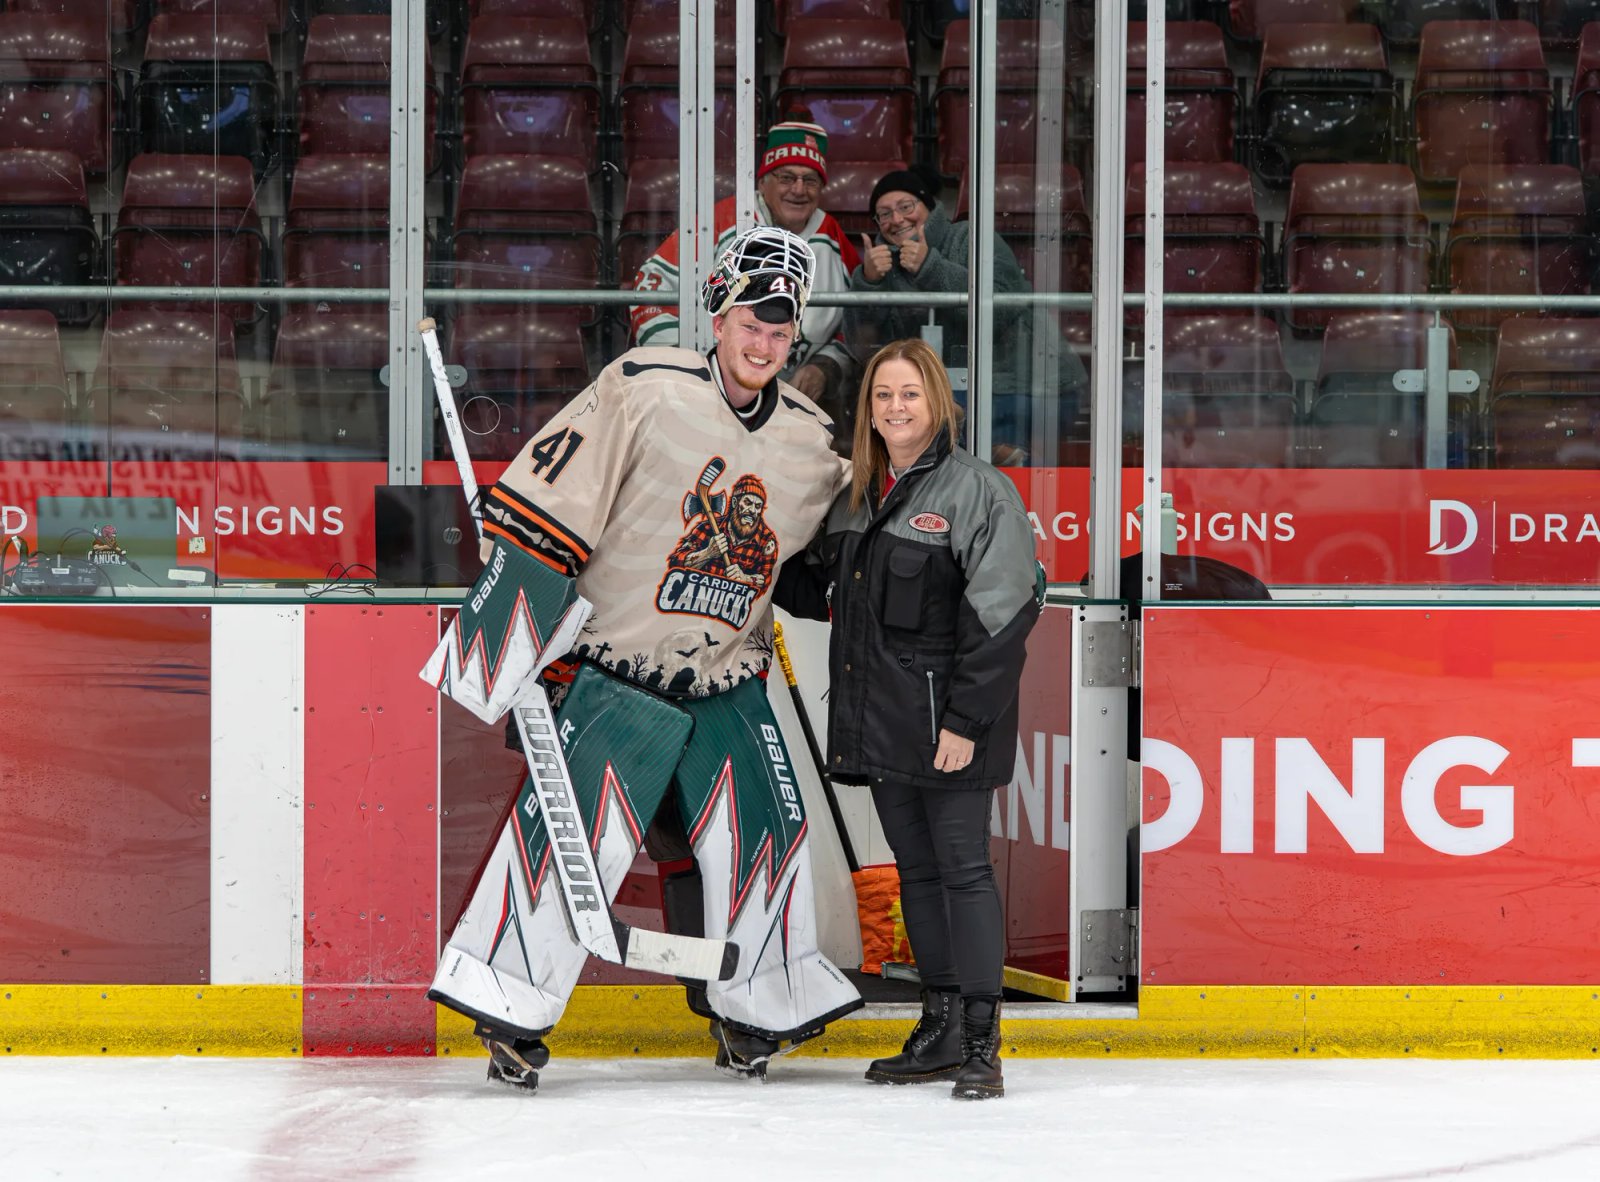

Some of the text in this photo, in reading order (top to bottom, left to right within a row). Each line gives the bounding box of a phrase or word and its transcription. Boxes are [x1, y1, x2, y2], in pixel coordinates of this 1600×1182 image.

[769, 276, 796, 297] 41
[530, 425, 585, 486] 41
[214, 506, 344, 536] SIGNS
[1509, 513, 1600, 543] DRA
[470, 546, 507, 614] BAUER
[659, 571, 757, 629] CANUCKS
[689, 573, 749, 595] CARDIFF
[760, 723, 802, 822] BAUER
[519, 707, 601, 914] WARRIOR
